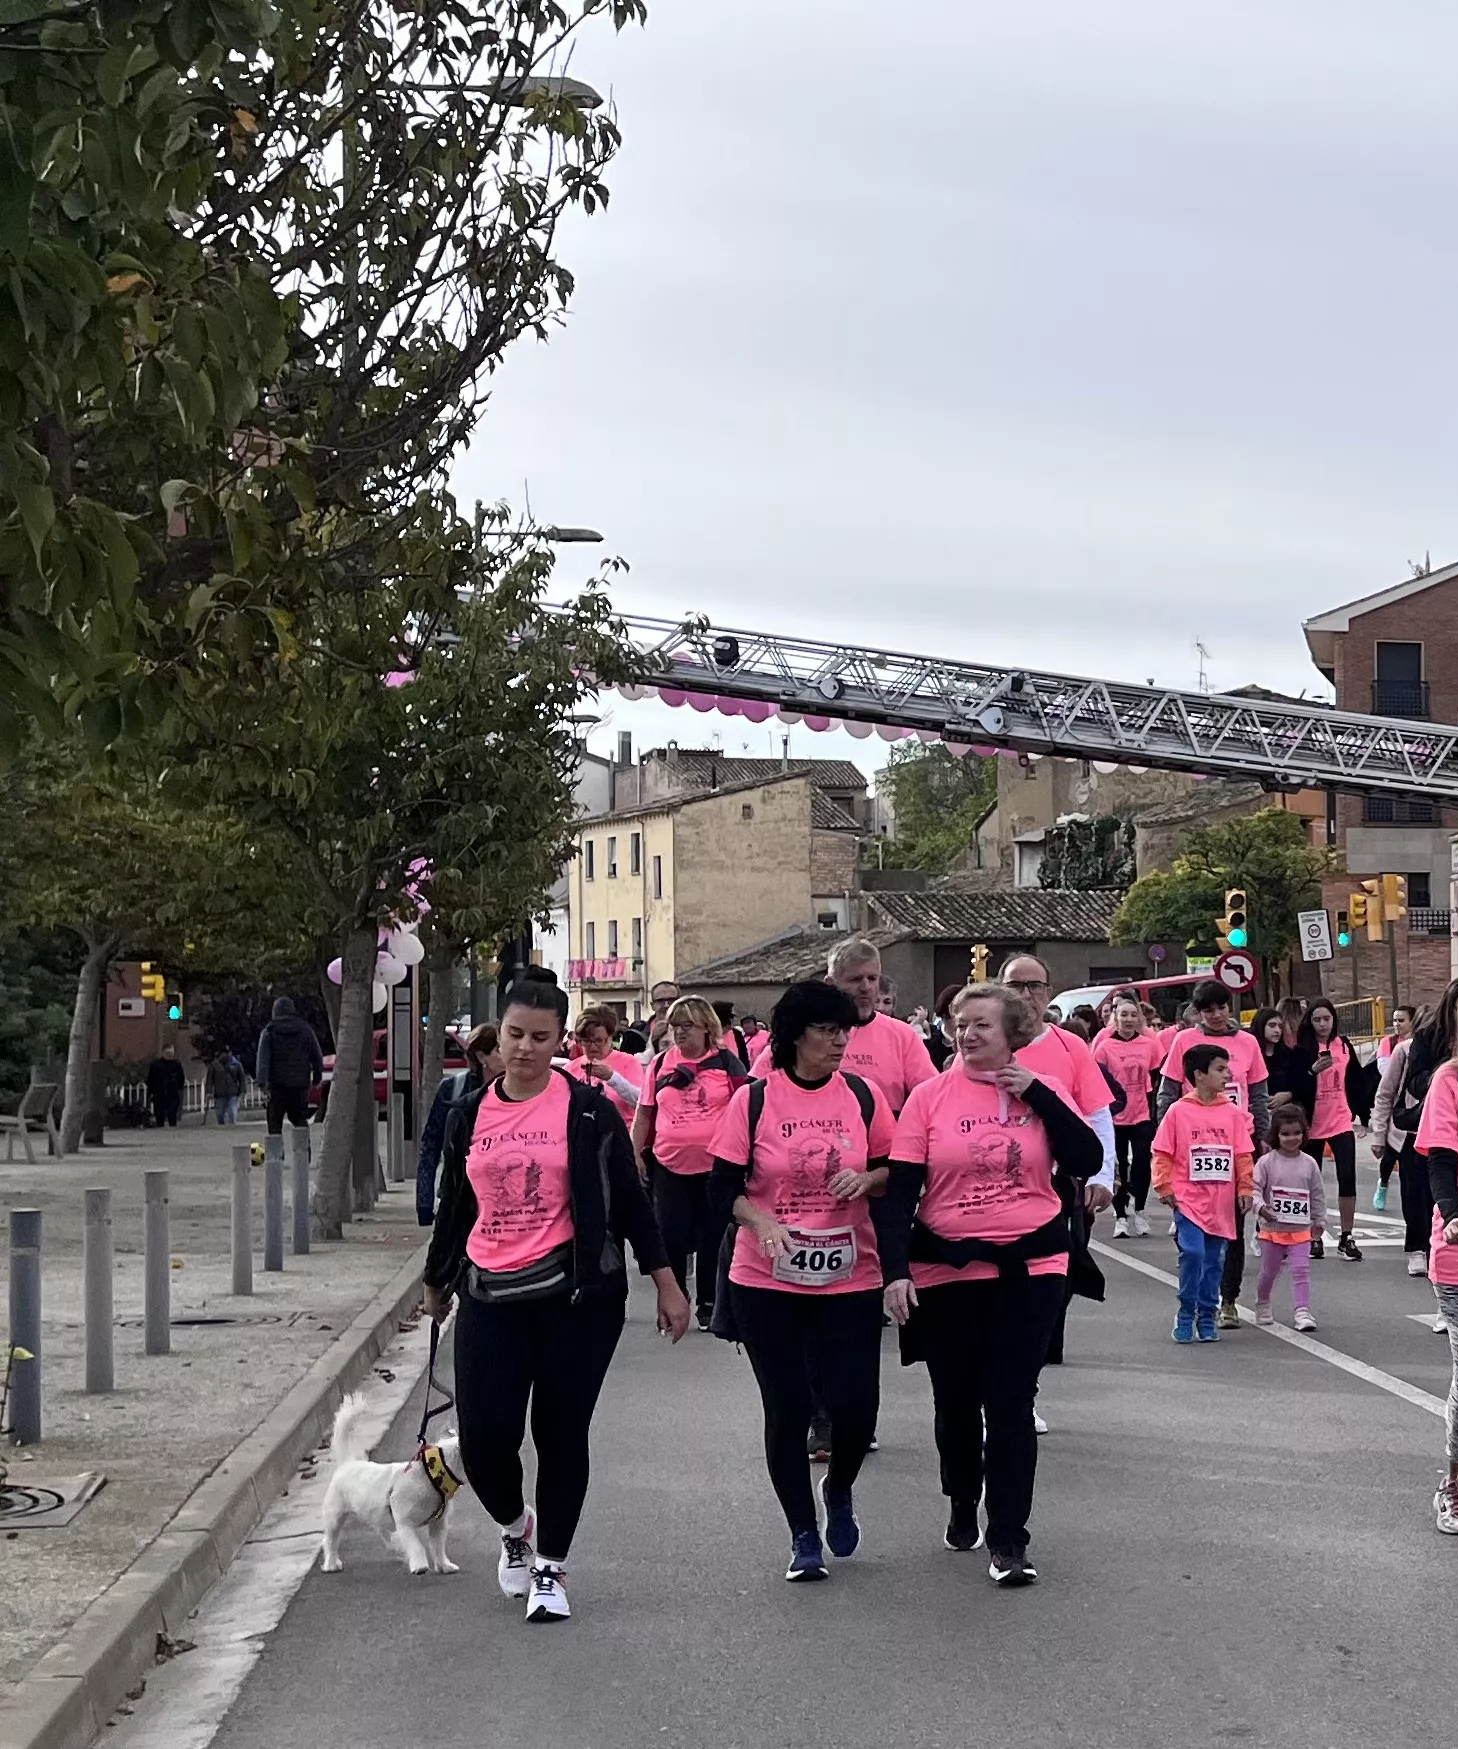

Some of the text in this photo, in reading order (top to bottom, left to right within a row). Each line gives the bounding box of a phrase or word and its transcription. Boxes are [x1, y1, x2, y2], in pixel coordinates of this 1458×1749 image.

[799, 1118, 843, 1129] CÁNCER
[1193, 1157, 1231, 1172] 3582
[1273, 1200, 1309, 1216] 3584
[790, 1249, 843, 1272] 406
